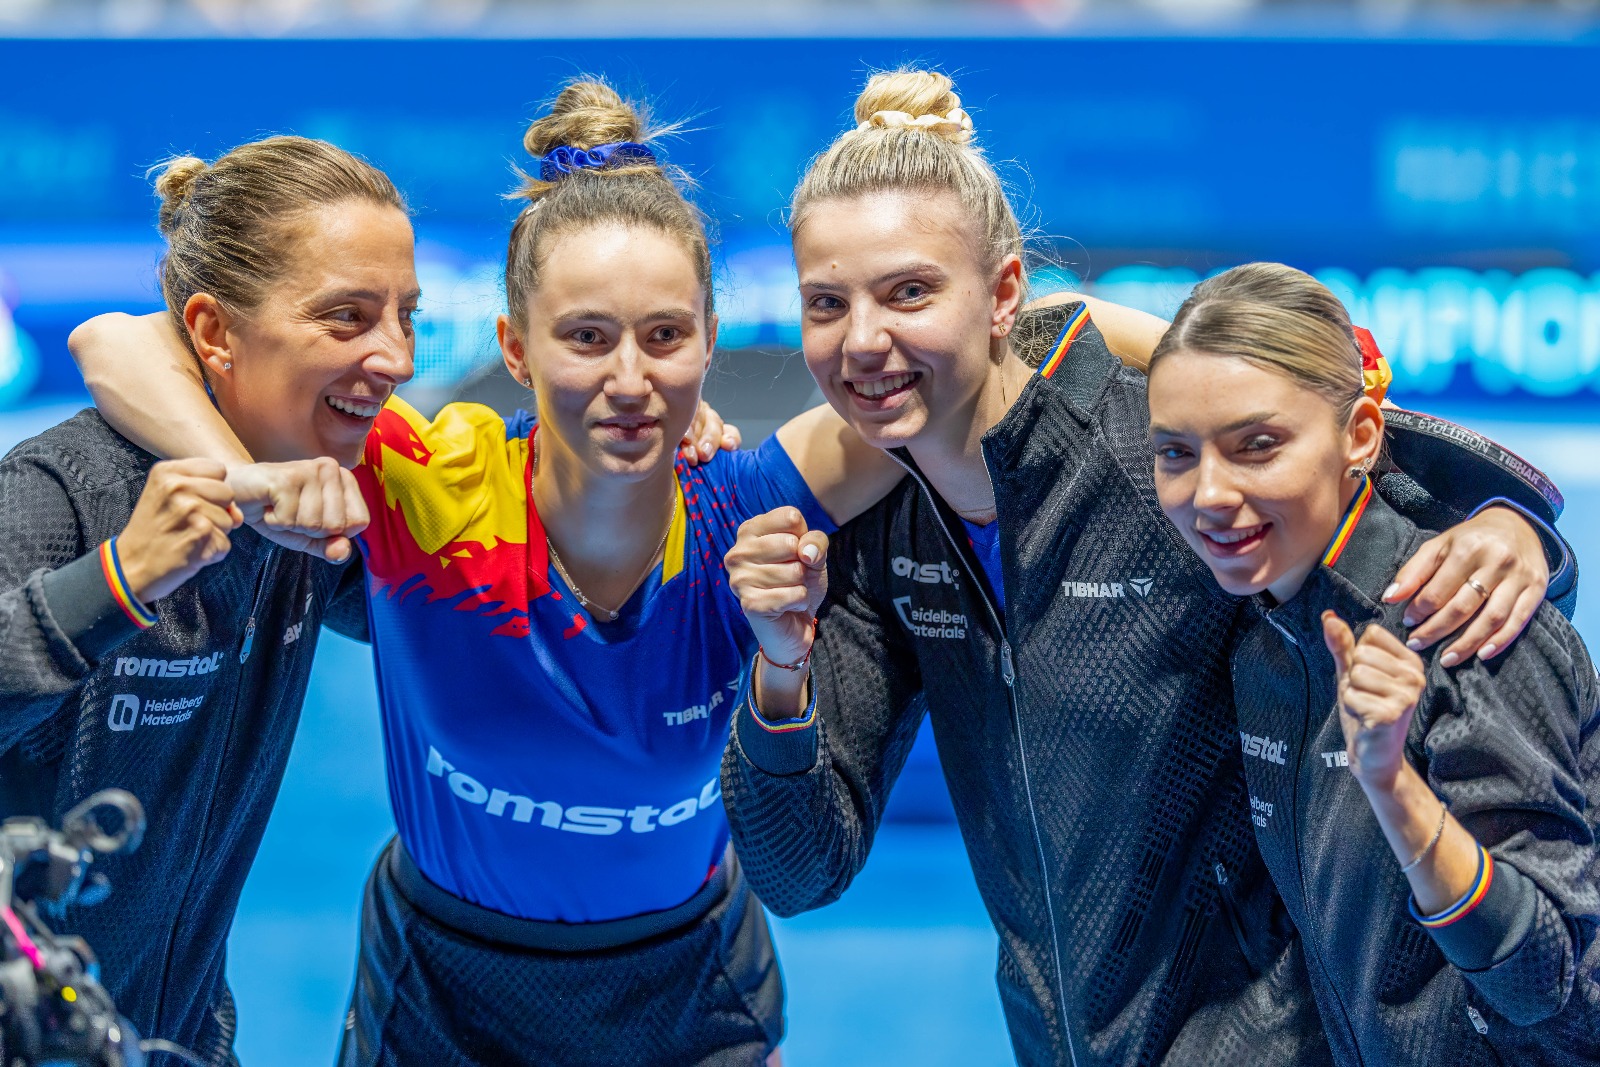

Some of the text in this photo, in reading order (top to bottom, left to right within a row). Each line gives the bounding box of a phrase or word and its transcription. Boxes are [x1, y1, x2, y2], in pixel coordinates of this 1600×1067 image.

[1383, 411, 1412, 424] BHAR
[1499, 450, 1541, 485] TIBHAR
[1061, 581, 1125, 598] TIBHAR
[911, 607, 969, 629] eidelber
[913, 624, 966, 639] aterials
[144, 695, 204, 712] Heidelberg
[140, 710, 193, 726] Materials
[1321, 751, 1350, 768] TIB
